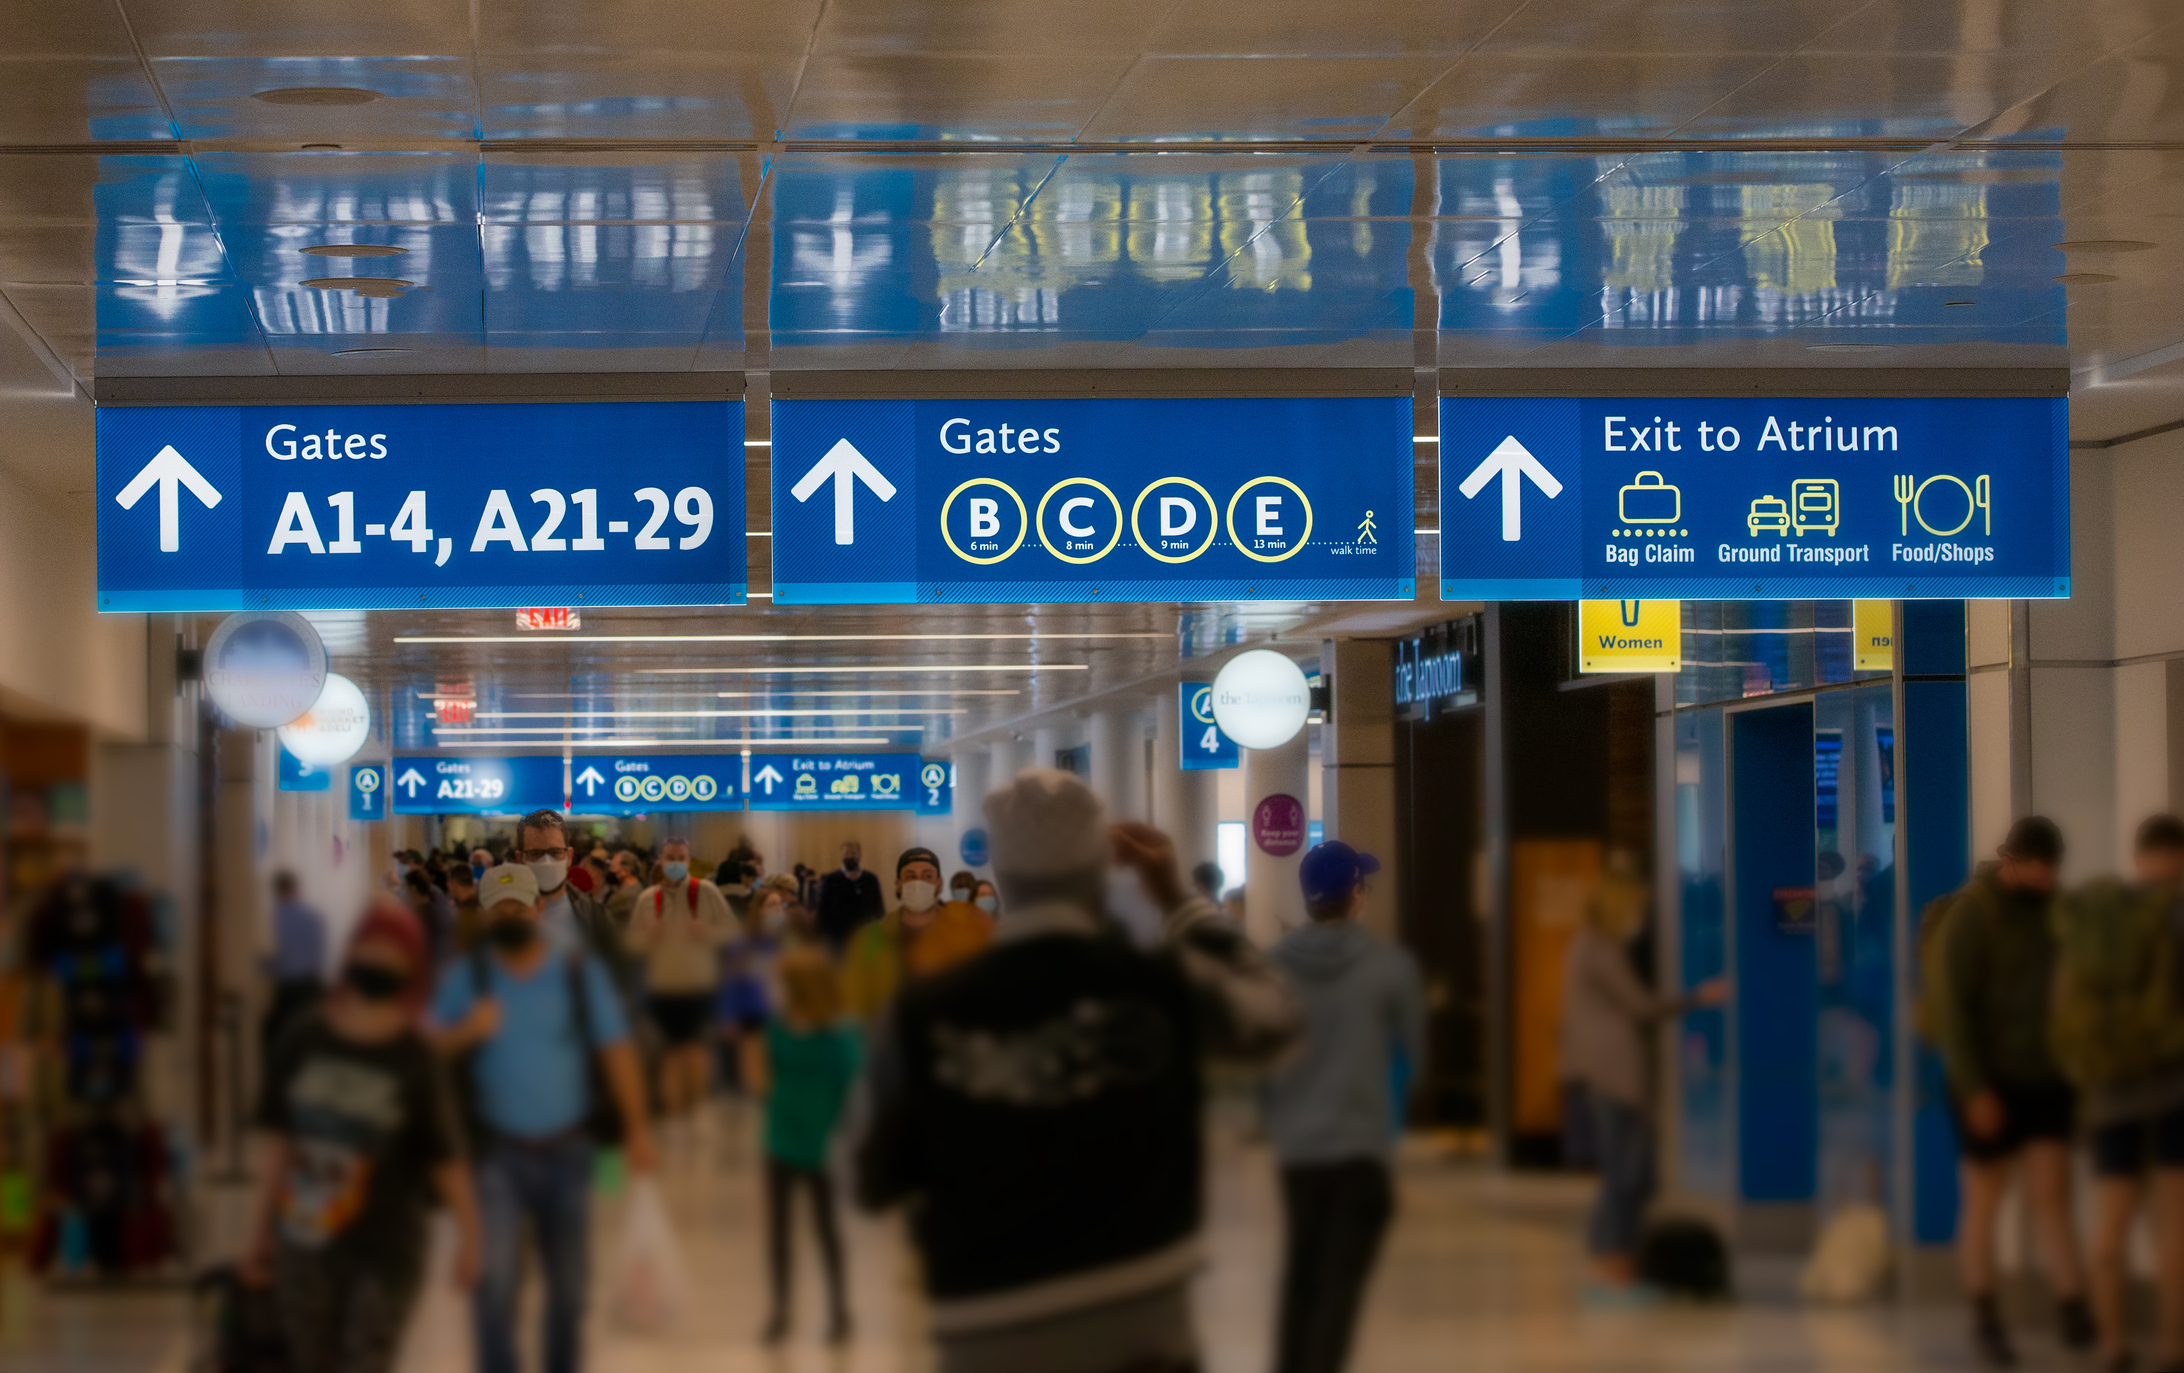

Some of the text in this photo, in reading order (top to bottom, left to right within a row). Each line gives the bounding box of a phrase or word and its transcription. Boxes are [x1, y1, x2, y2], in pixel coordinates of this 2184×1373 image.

[939, 417, 1061, 455] Gates
[1605, 415, 1898, 452] Exit to Atrium
[265, 423, 387, 461] Gates
[970, 498, 1000, 538] B
[1058, 497, 1096, 537] C
[1160, 497, 1197, 536] D
[1256, 496, 1283, 536] E
[267, 486, 714, 568] A1-4, A21-29
[970, 541, 999, 551] 6 min
[1065, 541, 1094, 550] 8 min
[1161, 540, 1189, 550] 9 min
[1253, 539, 1286, 549] 13 min
[1330, 545, 1377, 555] walk time
[1606, 543, 1695, 567] Bag Claim
[1718, 543, 1871, 567] Ground Transport
[1891, 542, 1994, 567] Food/Shops
[1598, 635, 1664, 649] Women
[209, 672, 321, 688] CHARTE'S
[1412, 637, 1462, 722] Taproom
[1220, 691, 1241, 705] the
[1200, 726, 1220, 753] 4
[436, 761, 472, 774] Gates
[614, 760, 650, 772] Gates
[792, 758, 876, 771] Exit to Atrium
[361, 774, 373, 787] A
[927, 768, 939, 782] A
[437, 778, 504, 799] A21-29
[623, 781, 633, 794] B
[646, 781, 658, 794] C
[673, 781, 685, 794] D
[698, 781, 708, 794] E
[362, 793, 372, 811] 1
[928, 789, 939, 806] 2
